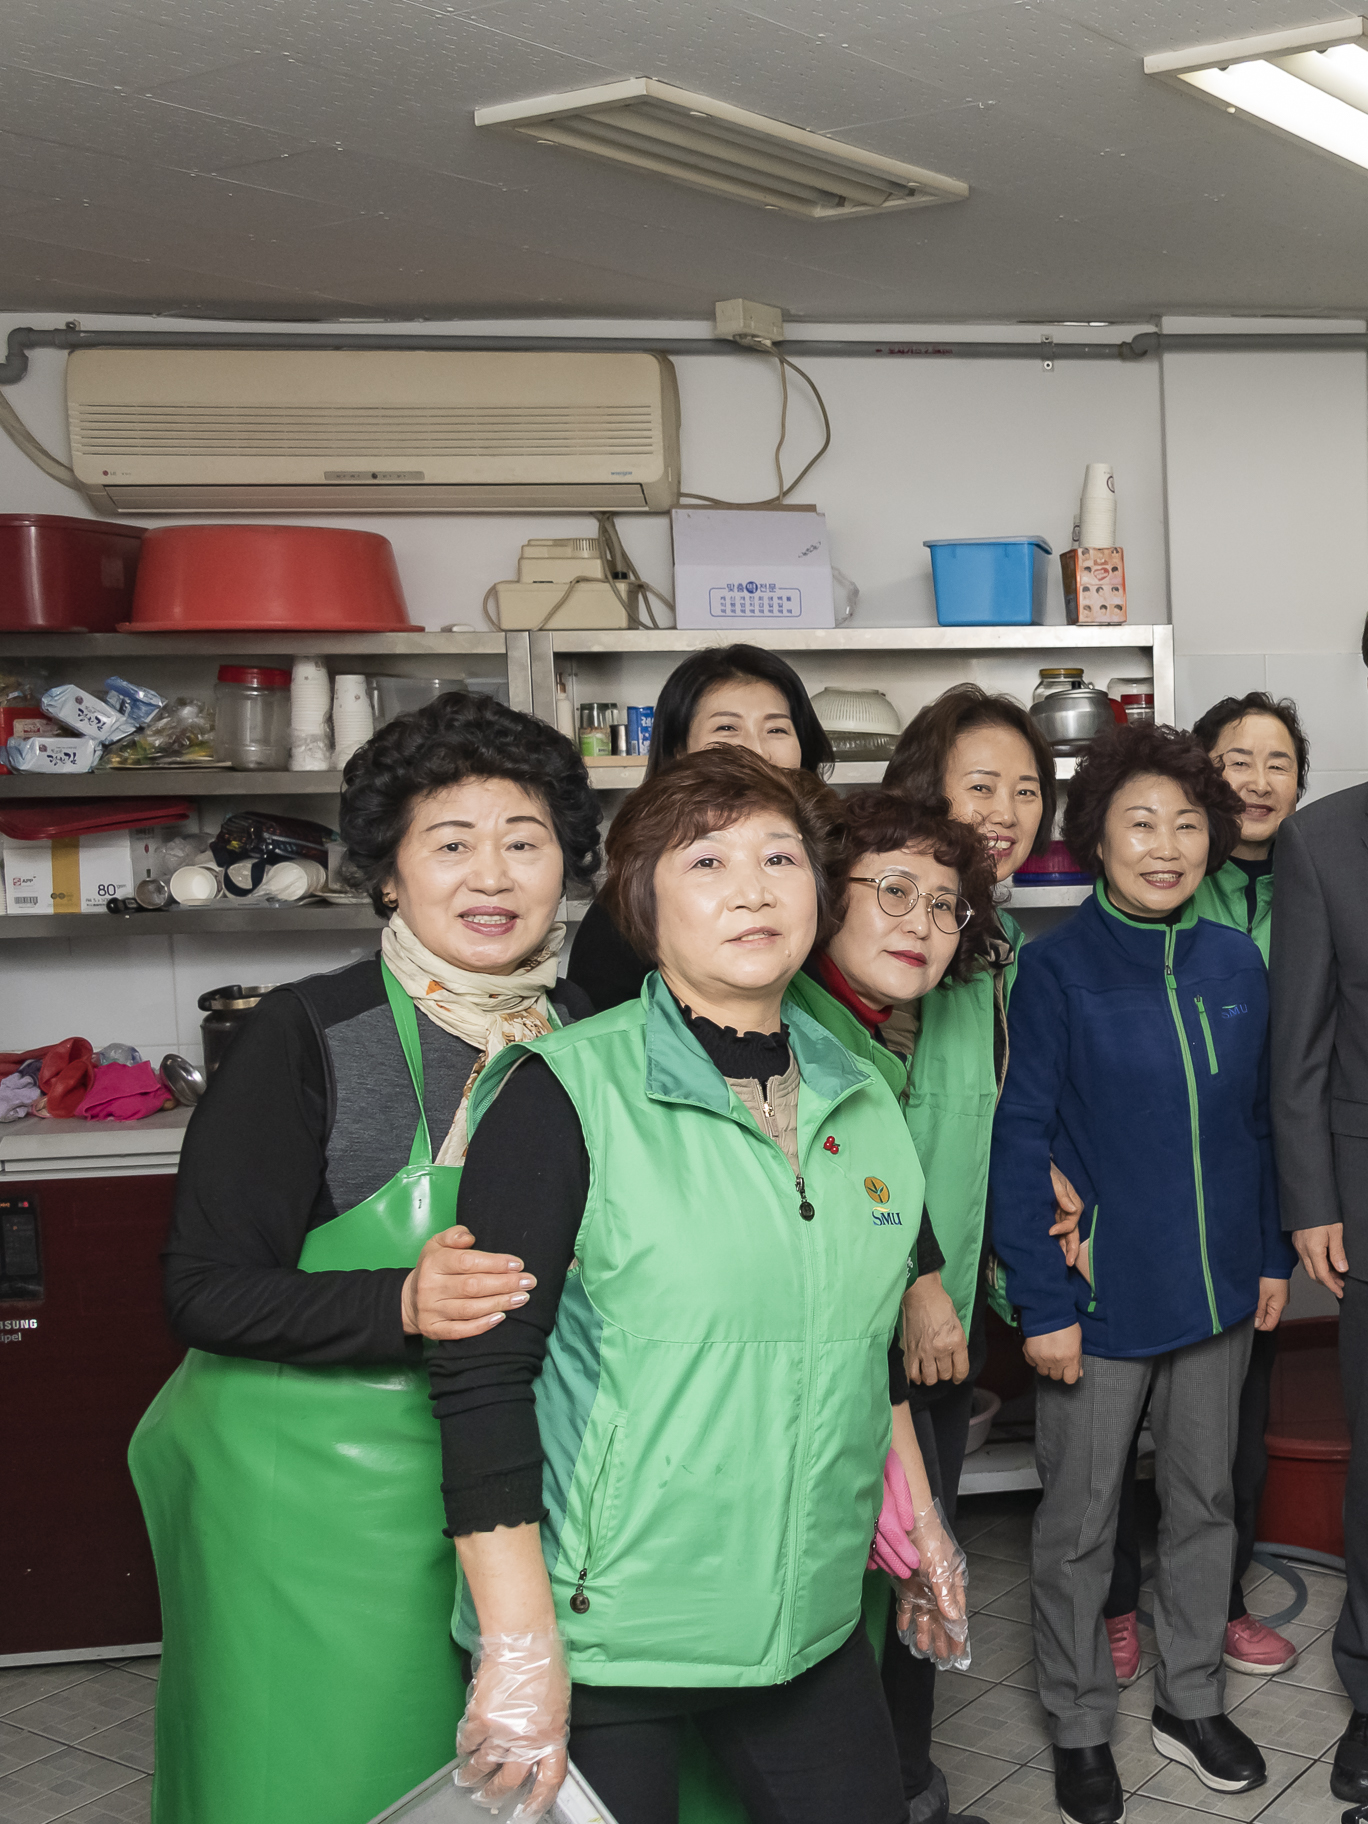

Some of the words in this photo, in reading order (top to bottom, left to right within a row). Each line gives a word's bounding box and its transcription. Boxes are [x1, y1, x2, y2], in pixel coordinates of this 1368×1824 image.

[97, 883, 116, 896] 80
[1221, 1004, 1248, 1020] SMU
[871, 1210, 903, 1226] SMU
[0, 1332, 22, 1344] ipel
